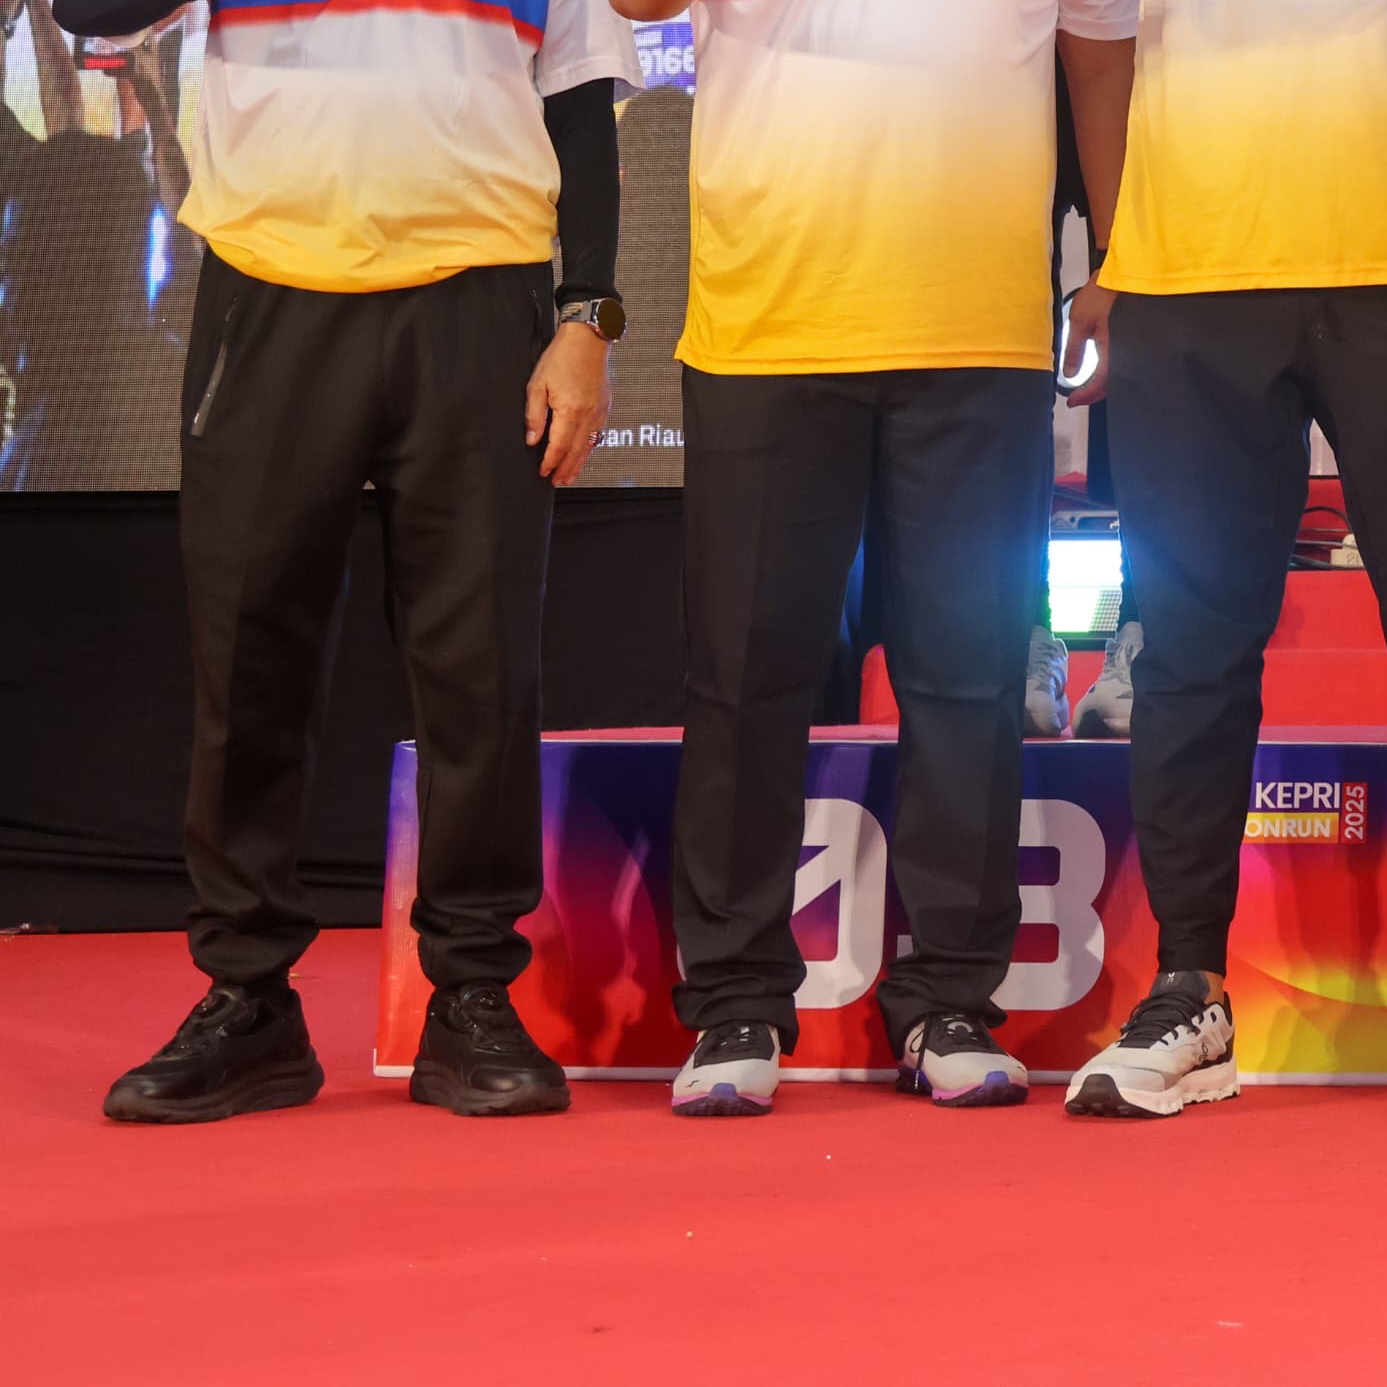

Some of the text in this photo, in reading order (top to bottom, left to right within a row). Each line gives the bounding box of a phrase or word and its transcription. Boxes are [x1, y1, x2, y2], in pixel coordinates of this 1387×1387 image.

[597, 430, 632, 447] an
[1255, 782, 1340, 808] KEPRI
[1344, 786, 1365, 840] 2025
